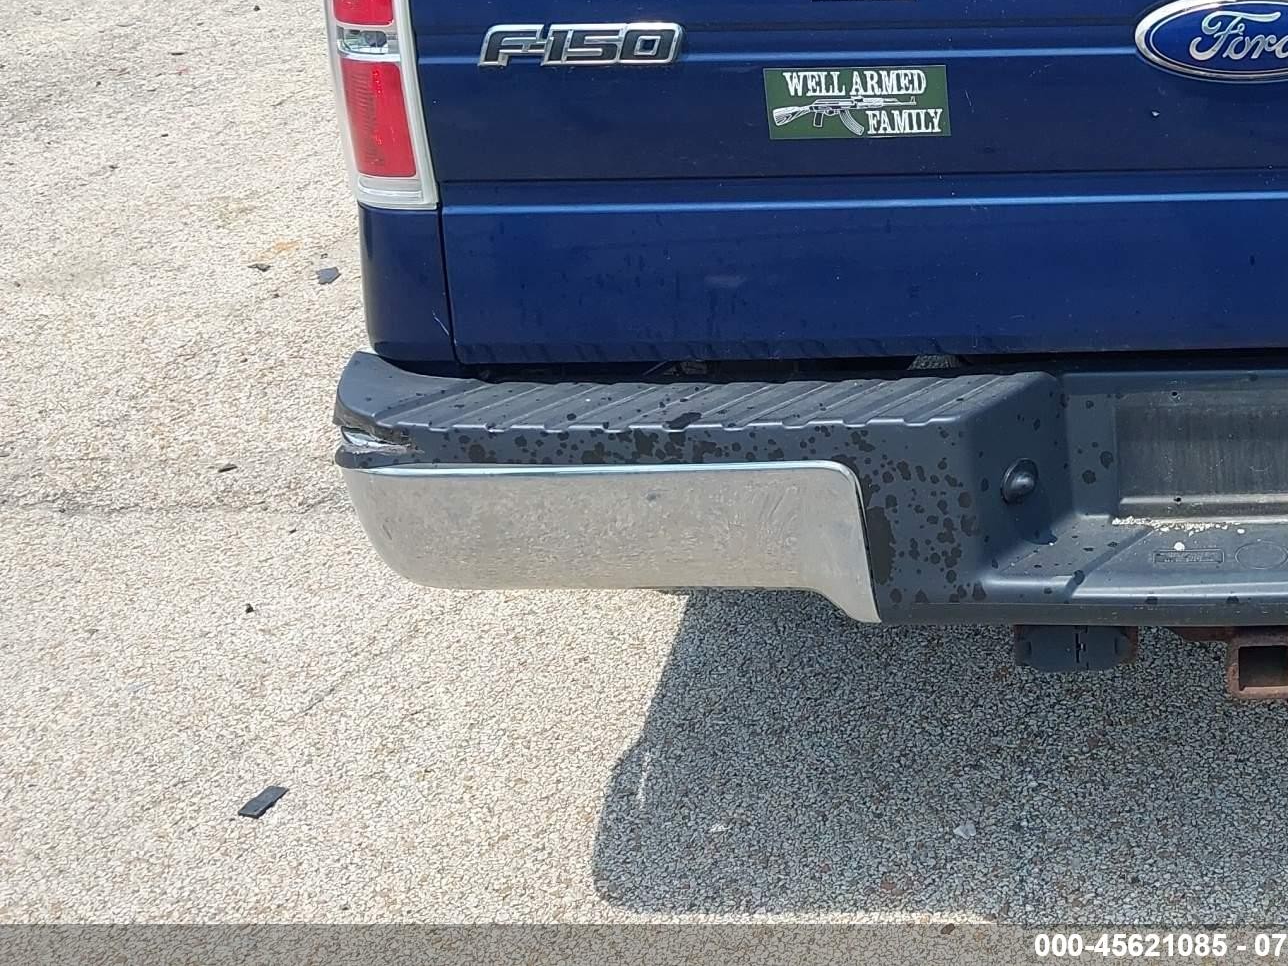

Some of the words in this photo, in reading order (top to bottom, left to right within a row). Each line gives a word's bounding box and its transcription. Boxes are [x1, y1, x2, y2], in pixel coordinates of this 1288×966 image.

[478, 22, 685, 67] F-150
[782, 71, 846, 96] WELL
[849, 69, 927, 96] ARMED
[866, 109, 943, 135] FAMILY
